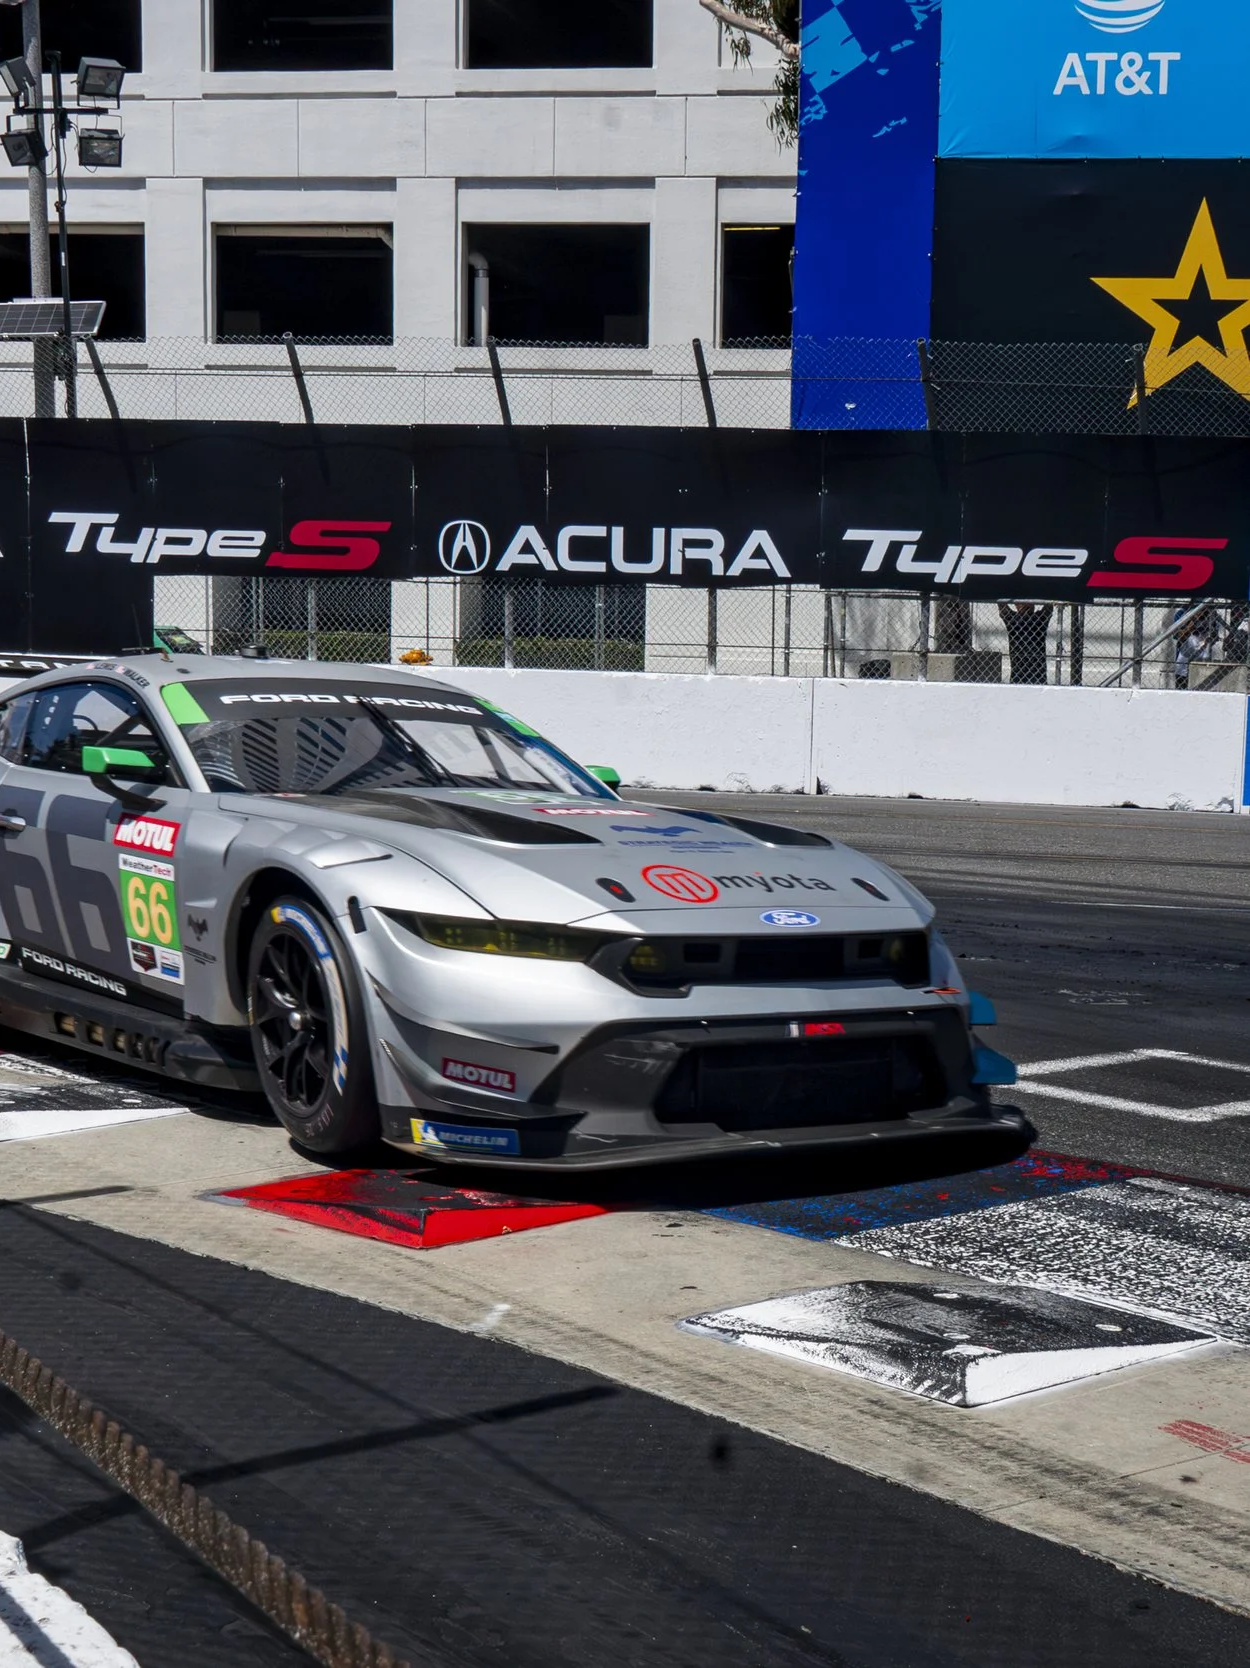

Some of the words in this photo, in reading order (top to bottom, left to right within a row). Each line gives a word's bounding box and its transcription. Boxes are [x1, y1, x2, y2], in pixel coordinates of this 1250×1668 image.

[1053, 51, 1181, 96] AT&T
[48, 511, 267, 563] Type
[265, 519, 392, 571] S
[495, 524, 792, 578] ACURA
[842, 528, 1089, 583] Type
[1086, 536, 1230, 590] S
[123, 667, 151, 689] WALKER
[219, 693, 342, 705] FORD
[344, 693, 484, 716] RACING
[544, 808, 650, 817] MOTUL
[116, 818, 176, 852] MOTUL
[121, 857, 172, 877] WeatherTech
[711, 870, 837, 893] myota
[127, 876, 173, 945] 66
[22, 946, 65, 973] FORD
[64, 962, 128, 996] RACING
[444, 1061, 513, 1090] MOTUL
[438, 1131, 509, 1147] MICHELIN
